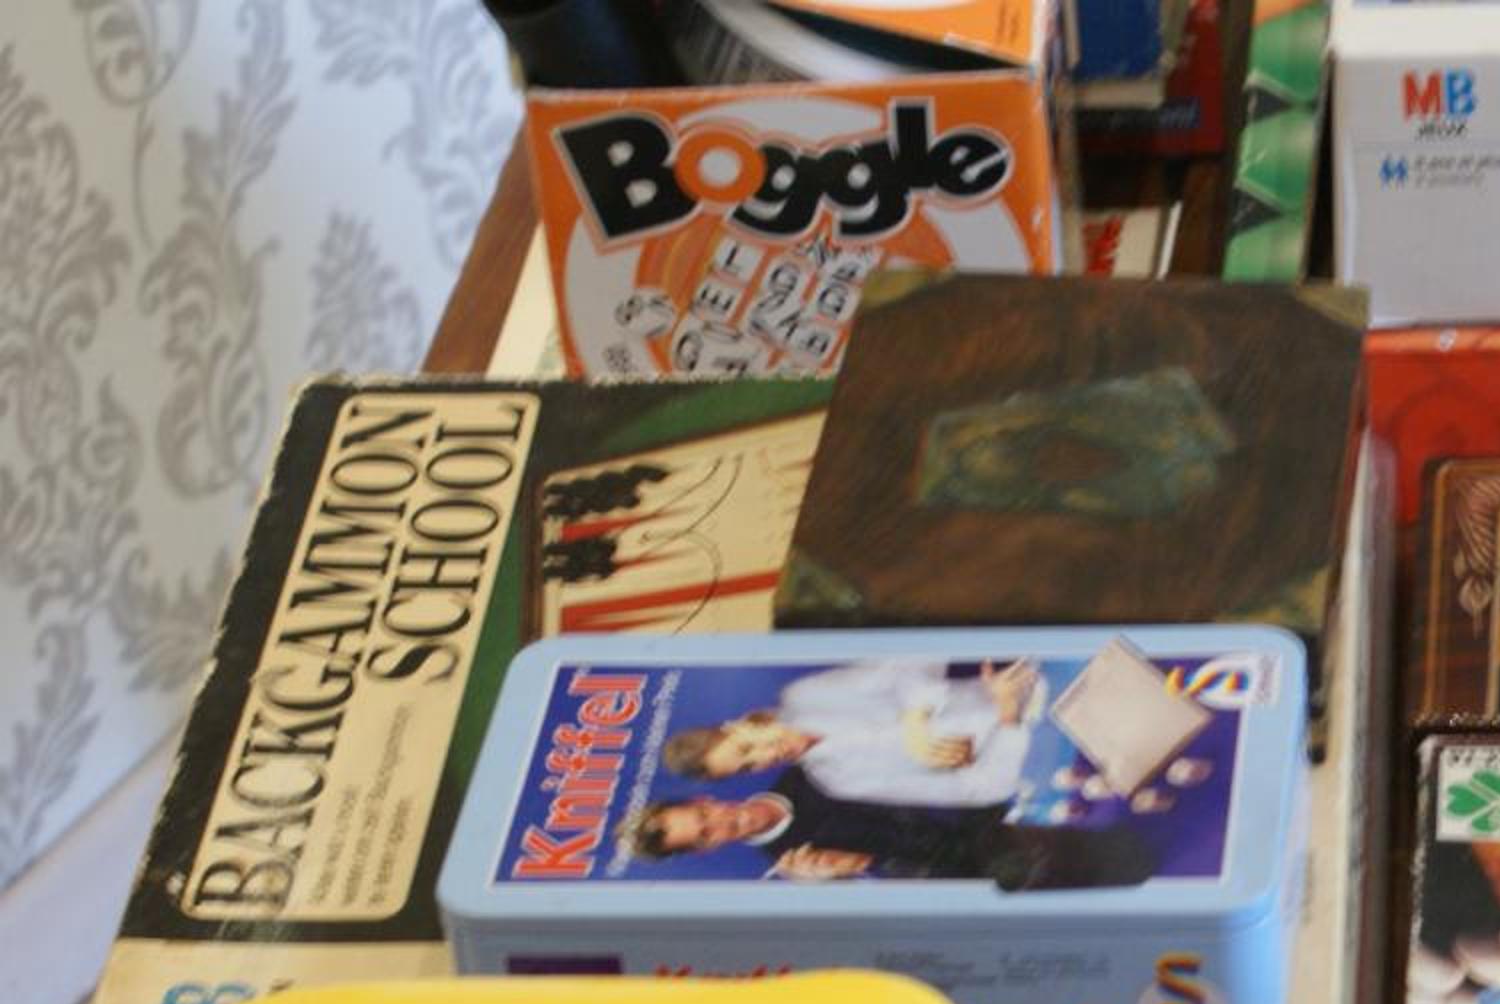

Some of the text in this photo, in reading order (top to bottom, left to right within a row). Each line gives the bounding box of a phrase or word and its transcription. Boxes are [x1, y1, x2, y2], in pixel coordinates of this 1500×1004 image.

[555, 100, 1013, 242] Boggle
[1403, 69, 1477, 118] MB
[364, 405, 528, 684] SCHOOL
[189, 400, 438, 913] BACKGAMMON
[510, 672, 648, 880] Kniffel
